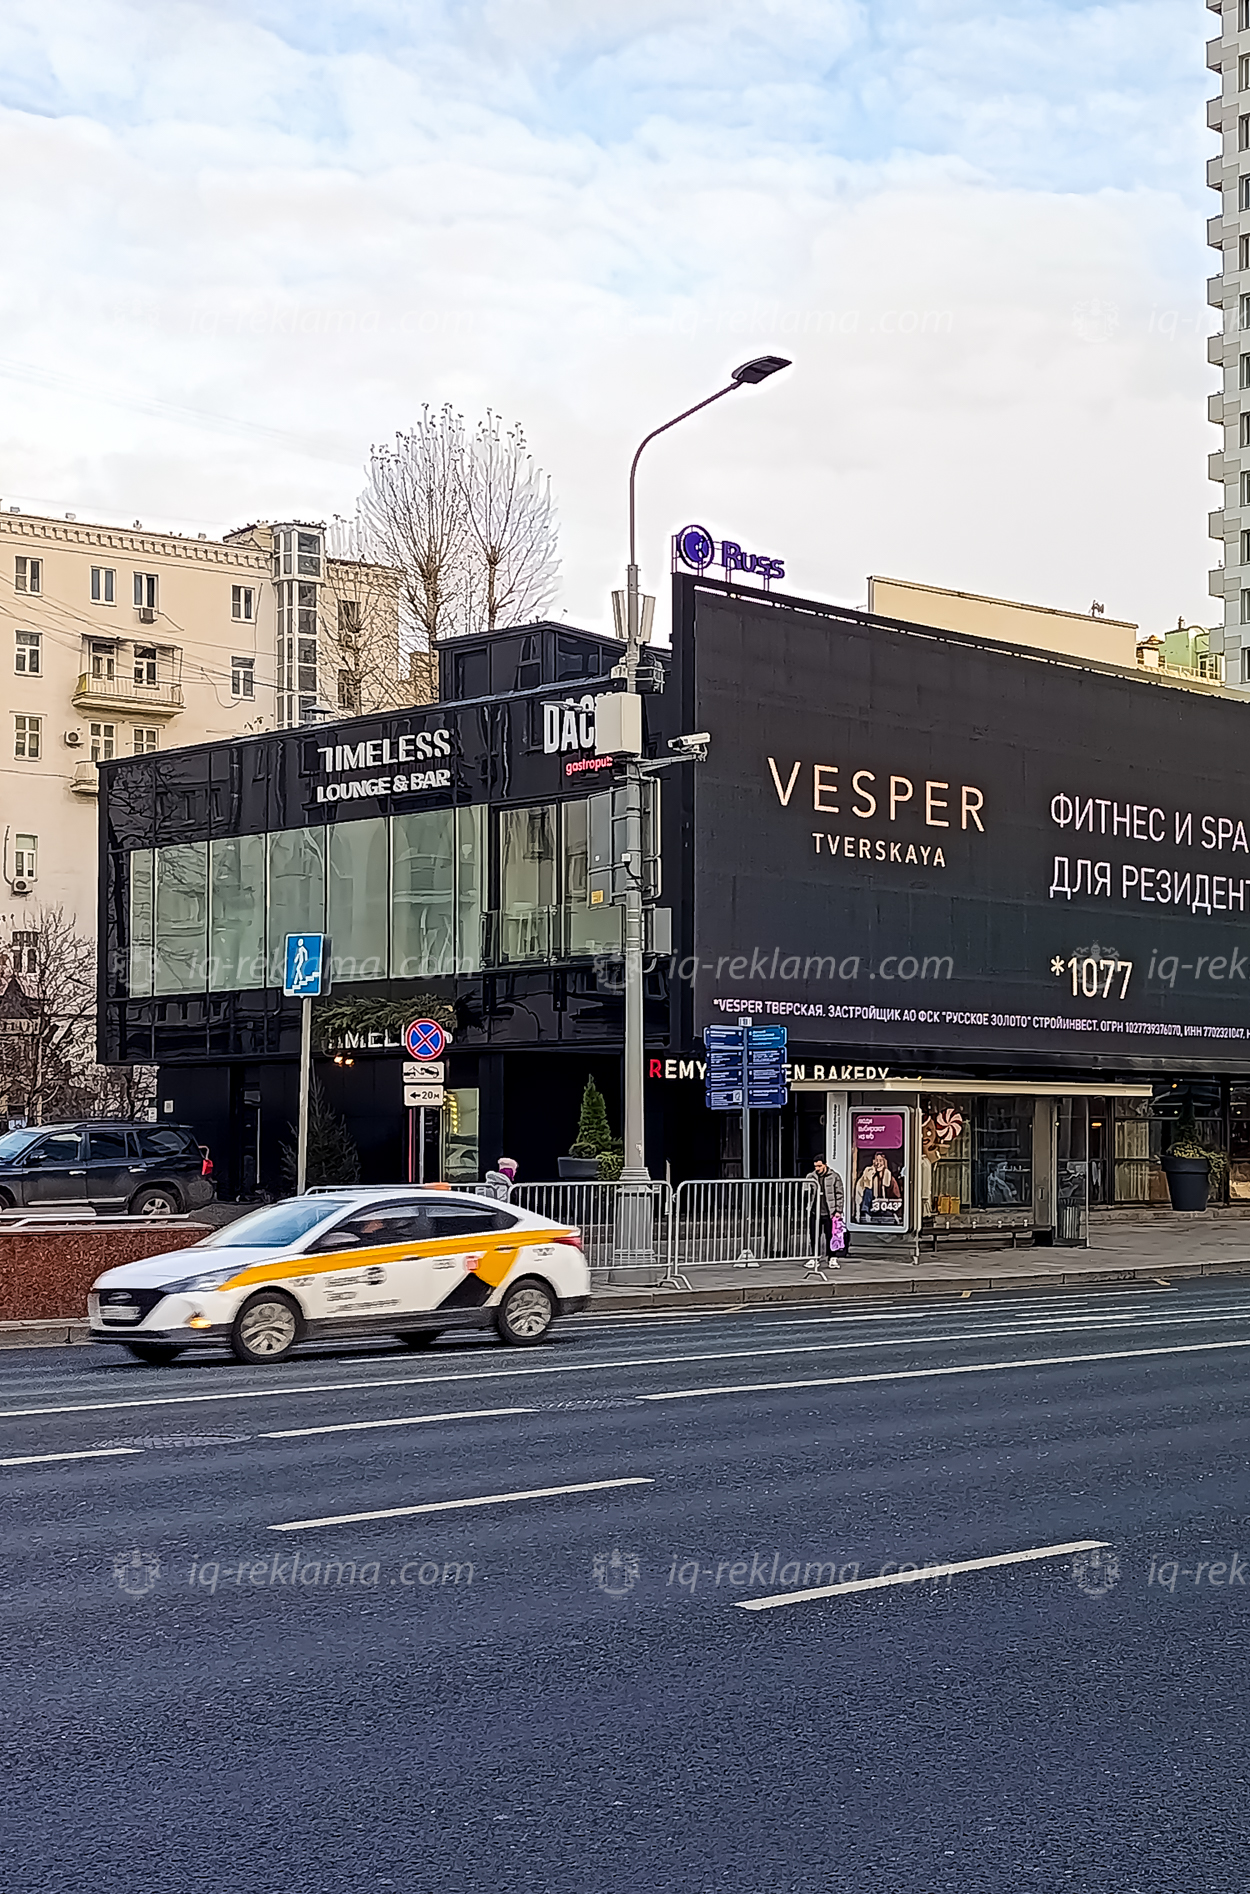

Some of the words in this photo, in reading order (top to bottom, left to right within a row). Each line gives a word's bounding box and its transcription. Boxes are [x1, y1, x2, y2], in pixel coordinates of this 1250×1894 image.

[722, 541, 785, 579] Russ
[317, 729, 450, 773] TIMELESS
[317, 777, 391, 802] LOUNGE
[392, 774, 408, 792] &
[410, 769, 450, 790] BAR
[767, 757, 986, 832] VESPER
[1051, 793, 1166, 842] ФИТНЕС
[1174, 812, 1193, 846] И
[1201, 815, 1249, 854] SPA
[812, 833, 946, 868] TVERSKAYA
[1049, 855, 1111, 900] ДЛЯ
[828, 1004, 901, 1023] ЗАСТРОЙЩИК
[902, 1009, 917, 1022] АО
[918, 1010, 940, 1023] ФСК
[1100, 1020, 1124, 1033] ОГРН
[649, 1058, 708, 1080] REMY
